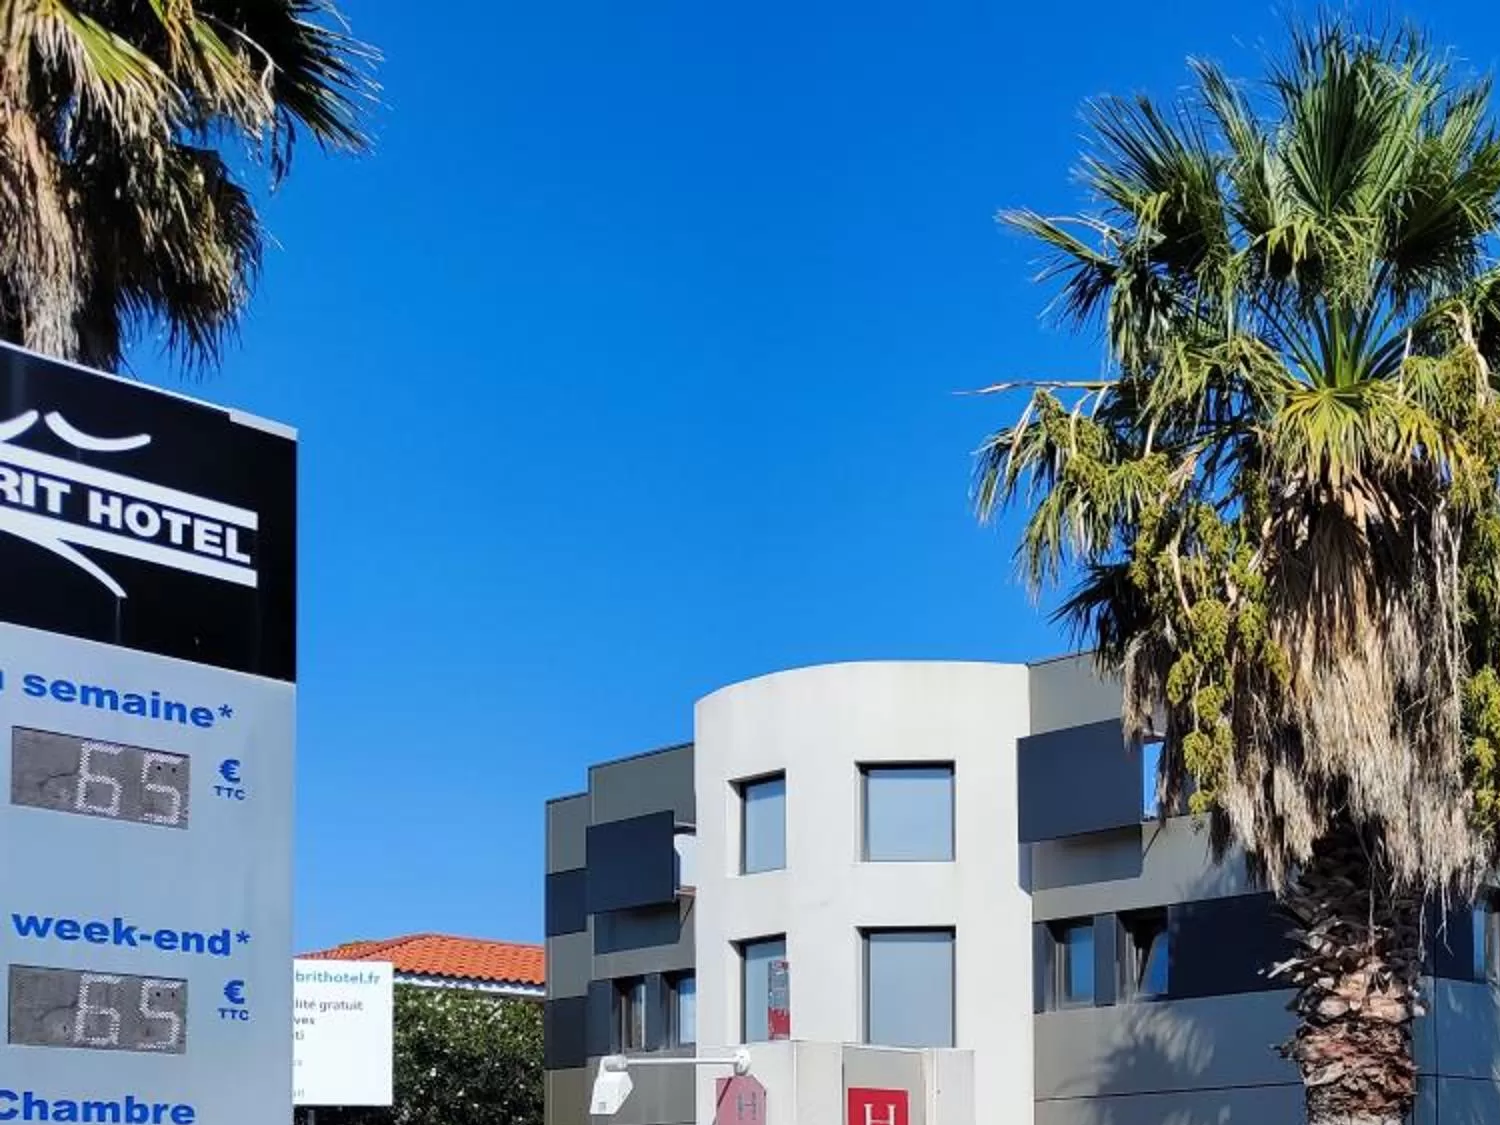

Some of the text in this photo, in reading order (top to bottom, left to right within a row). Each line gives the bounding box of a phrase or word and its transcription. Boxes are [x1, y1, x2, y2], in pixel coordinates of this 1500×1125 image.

[88, 489, 251, 564] HOTEL
[75, 740, 183, 825] 65
[213, 785, 246, 801] TTC
[74, 973, 183, 1049] 65
[217, 1007, 249, 1021] TTC
[320, 1000, 364, 1012] gratuit
[0, 1089, 196, 1125] Chambre
